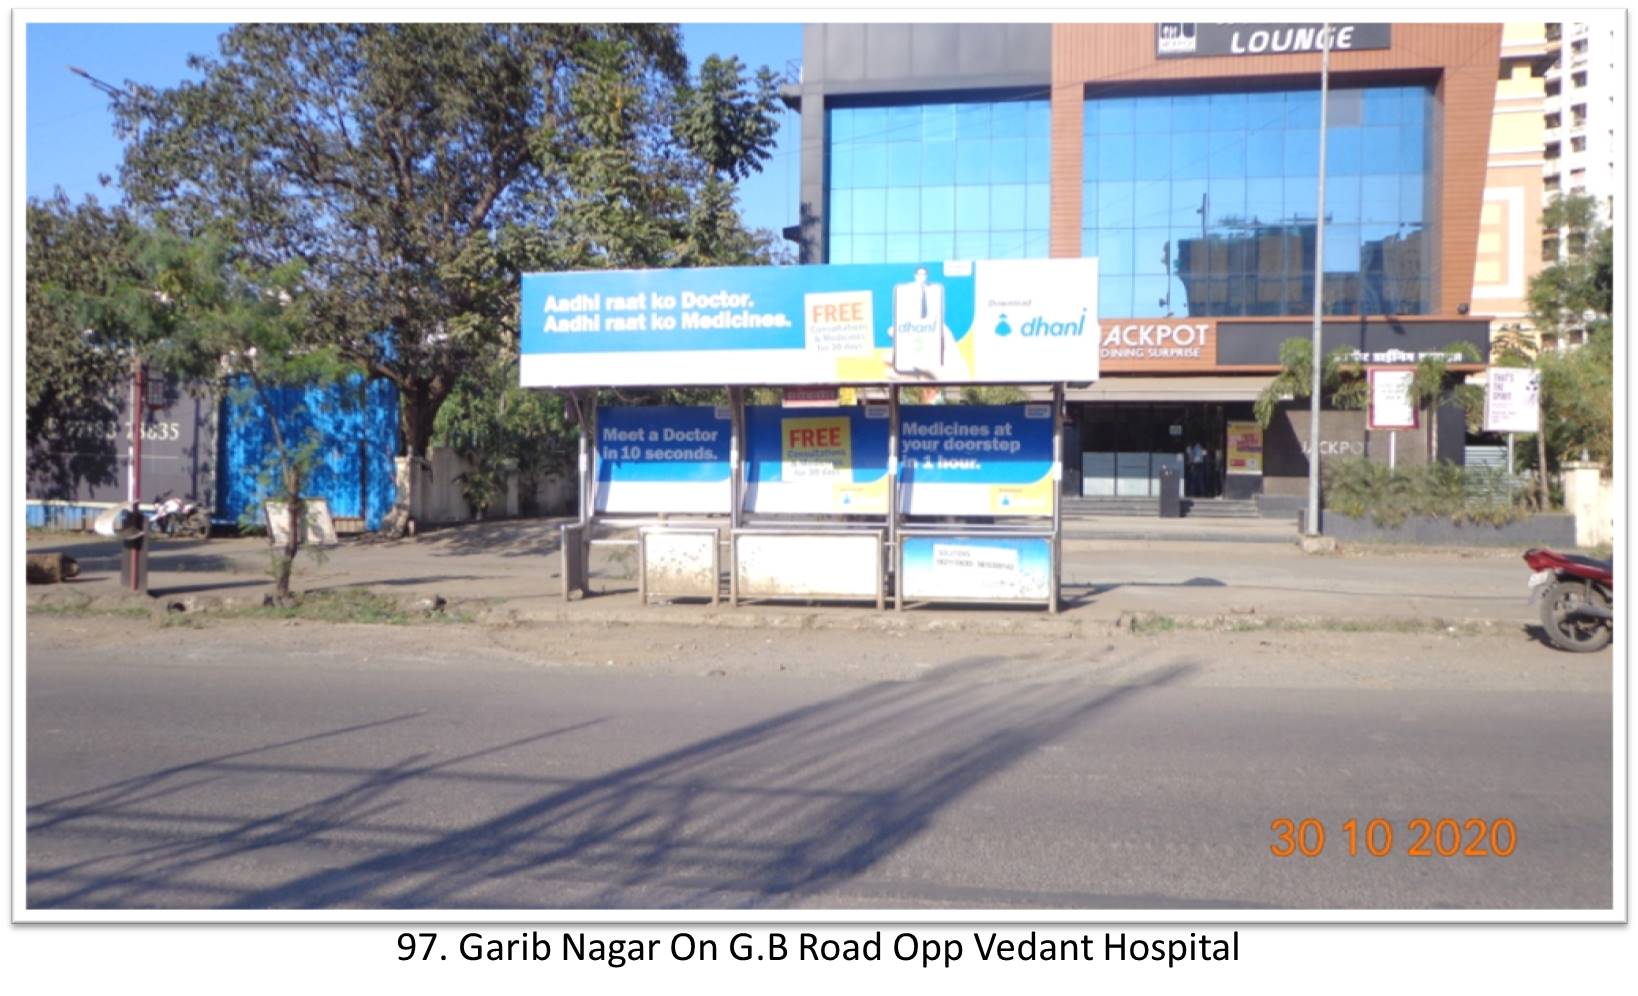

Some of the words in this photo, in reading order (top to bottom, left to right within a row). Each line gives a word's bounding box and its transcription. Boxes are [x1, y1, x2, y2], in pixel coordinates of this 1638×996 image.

[1231, 26, 1354, 54] LOUNGE
[544, 294, 600, 313] Aadhi
[605, 293, 646, 311] raat
[651, 292, 676, 310] ko
[681, 290, 754, 309] Doctor.
[544, 314, 600, 333] Aadhi
[605, 313, 646, 331] raat
[651, 312, 676, 330] ko
[681, 310, 792, 329] Medicines.
[812, 302, 864, 323] FREE
[1020, 307, 1088, 337] dhani
[898, 317, 937, 334] dhani
[1102, 324, 1209, 346] ACKPOT
[1101, 347, 1144, 358] DINING
[1148, 347, 1200, 358] SURPRISE
[603, 427, 645, 441] Meet
[649, 430, 659, 441] a
[663, 427, 718, 442] Doctor
[789, 427, 841, 448] FREE
[902, 422, 989, 437] Medicines
[994, 422, 1012, 436] at
[603, 446, 618, 460] in
[621, 446, 641, 460] 10
[645, 445, 718, 460] seconds.
[902, 438, 939, 452] your
[943, 436, 1021, 453] doorstep
[902, 455, 918, 468] in
[922, 456, 933, 469] 1
[938, 455, 982, 470] hour.
